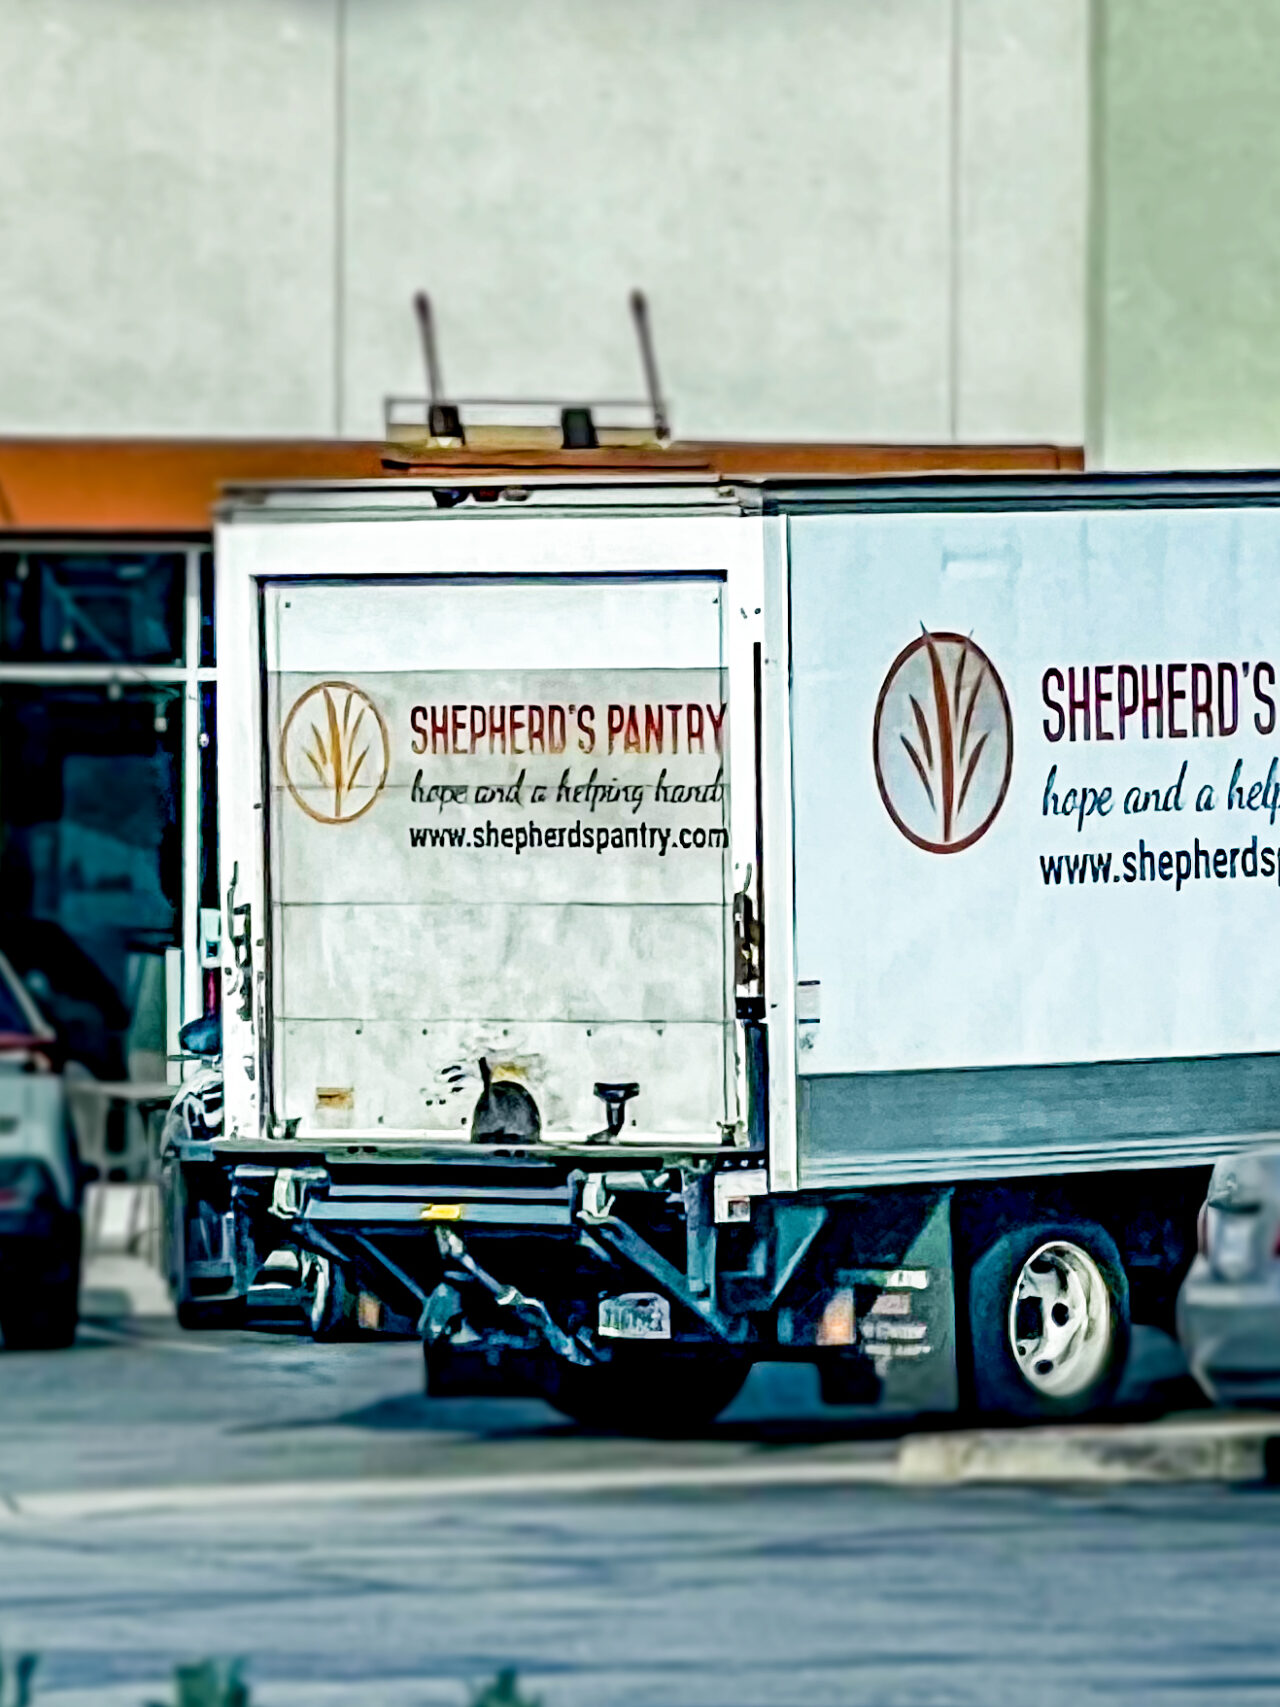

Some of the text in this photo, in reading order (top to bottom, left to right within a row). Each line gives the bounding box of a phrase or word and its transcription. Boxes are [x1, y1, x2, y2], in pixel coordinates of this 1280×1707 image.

[1041, 660, 1276, 743] SHEPHERD'S
[410, 703, 727, 756] SHEPHERD'S PANTRY
[411, 768, 725, 814] hope and a helping hand
[1042, 764, 1113, 832] hope
[1123, 760, 1188, 815] and
[1195, 784, 1216, 812] a
[410, 820, 729, 857] www.shepherdspantry.com
